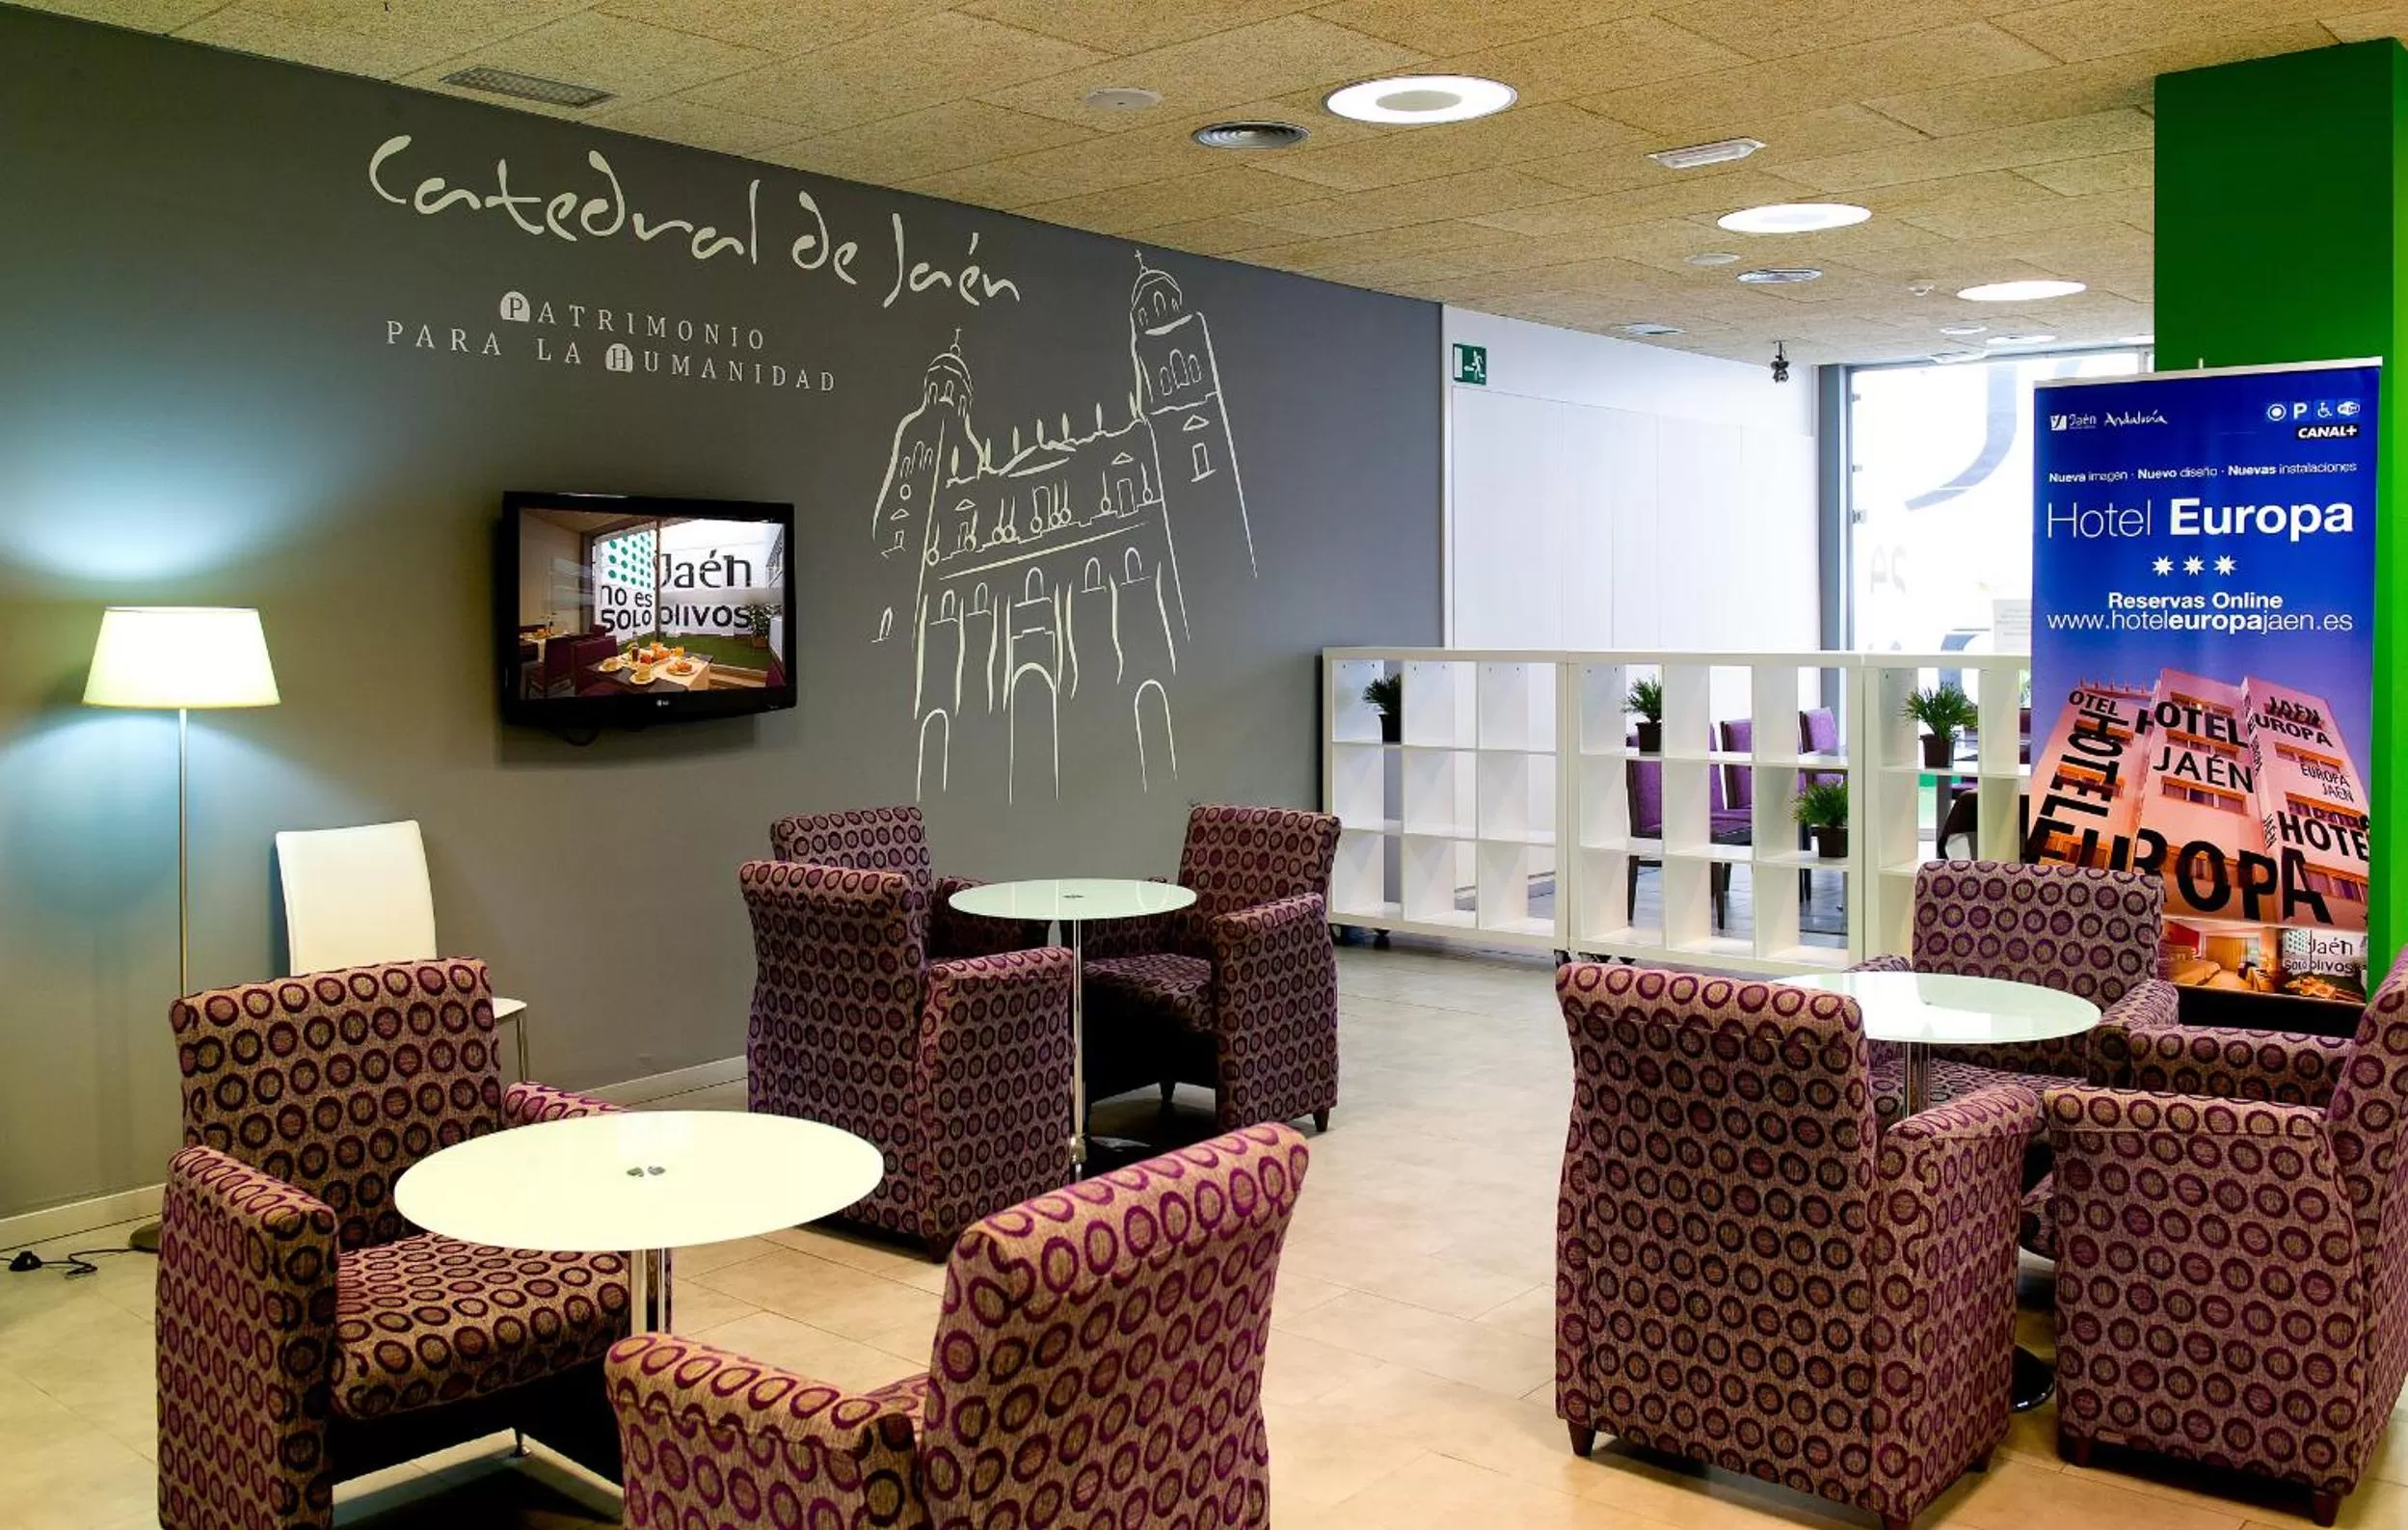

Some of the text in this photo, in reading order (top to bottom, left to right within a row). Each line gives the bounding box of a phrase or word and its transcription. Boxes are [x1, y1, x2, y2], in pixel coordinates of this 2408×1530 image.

[369, 135, 1020, 309] Catedral de Jaén
[500, 291, 763, 350] PATRIMONIO
[387, 320, 835, 392] PARA LA HUMANIDAD
[2298, 424, 2358, 439] CANAL+
[2048, 462, 2358, 483] Nueva imagen Nuevo diseño Nuevas instalaciones
[2047, 497, 2354, 542] Hotel Europa
[655, 549, 752, 589] Jaén
[634, 590, 653, 607] es
[660, 604, 752, 629] olivos
[2108, 591, 2284, 609] Reservas Online
[2047, 609, 2354, 634] www.hoteleuropajaen.es
[2069, 690, 2120, 717] OTEL
[2040, 709, 2129, 819] HOTEL
[2153, 746, 2254, 793] JAÉN
[2277, 811, 2369, 862] HOTE
